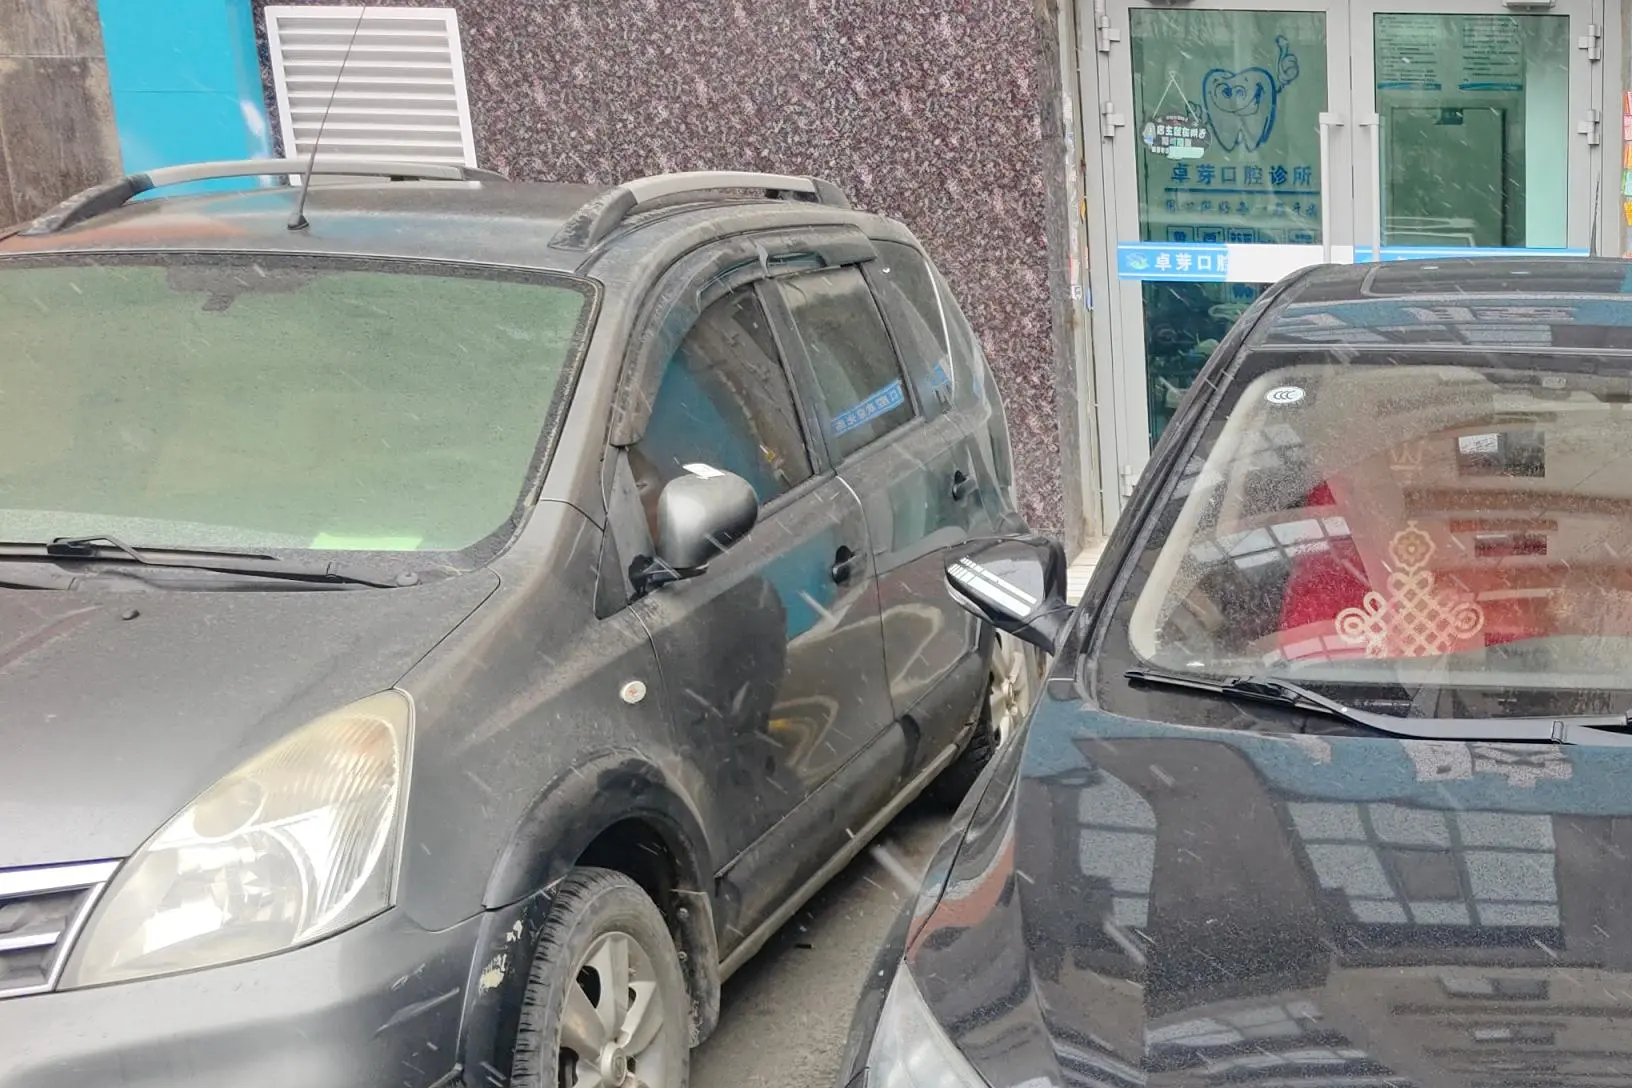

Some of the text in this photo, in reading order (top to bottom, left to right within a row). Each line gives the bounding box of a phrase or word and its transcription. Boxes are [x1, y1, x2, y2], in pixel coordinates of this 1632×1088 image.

[1170, 163, 1312, 185] 卓芽口腔诊所
